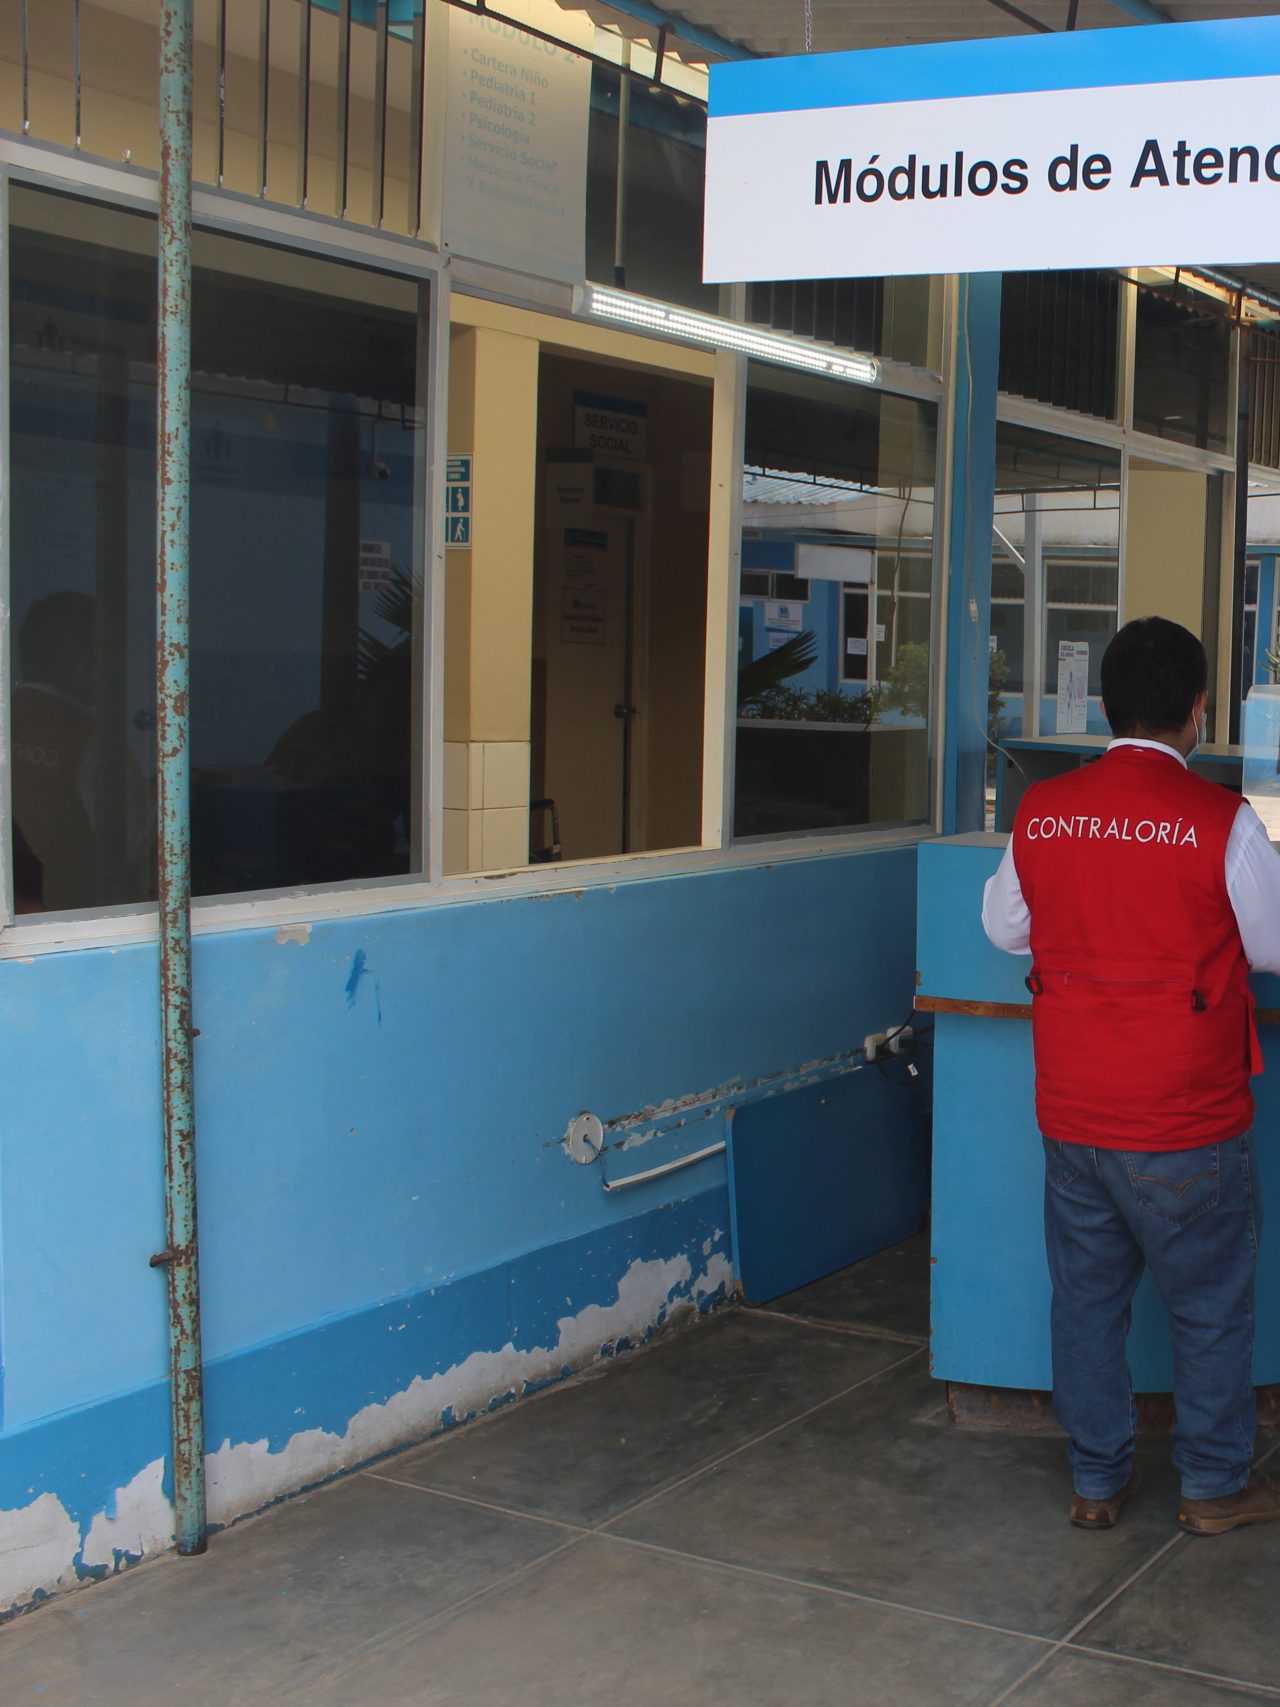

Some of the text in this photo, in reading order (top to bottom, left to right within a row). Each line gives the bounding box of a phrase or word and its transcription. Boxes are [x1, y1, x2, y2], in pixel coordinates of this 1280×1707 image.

[471, 47, 549, 89] Cartera Niño
[529, 90, 537, 106] 1
[528, 111, 537, 128] 2
[468, 132, 558, 174] Servicio Social
[815, 152, 1028, 204] Módulos
[1048, 144, 1111, 192] de
[583, 411, 639, 436] SERVICIO
[590, 432, 633, 454] SOCIAL
[1026, 815, 1198, 848] CONTRALORÍA
